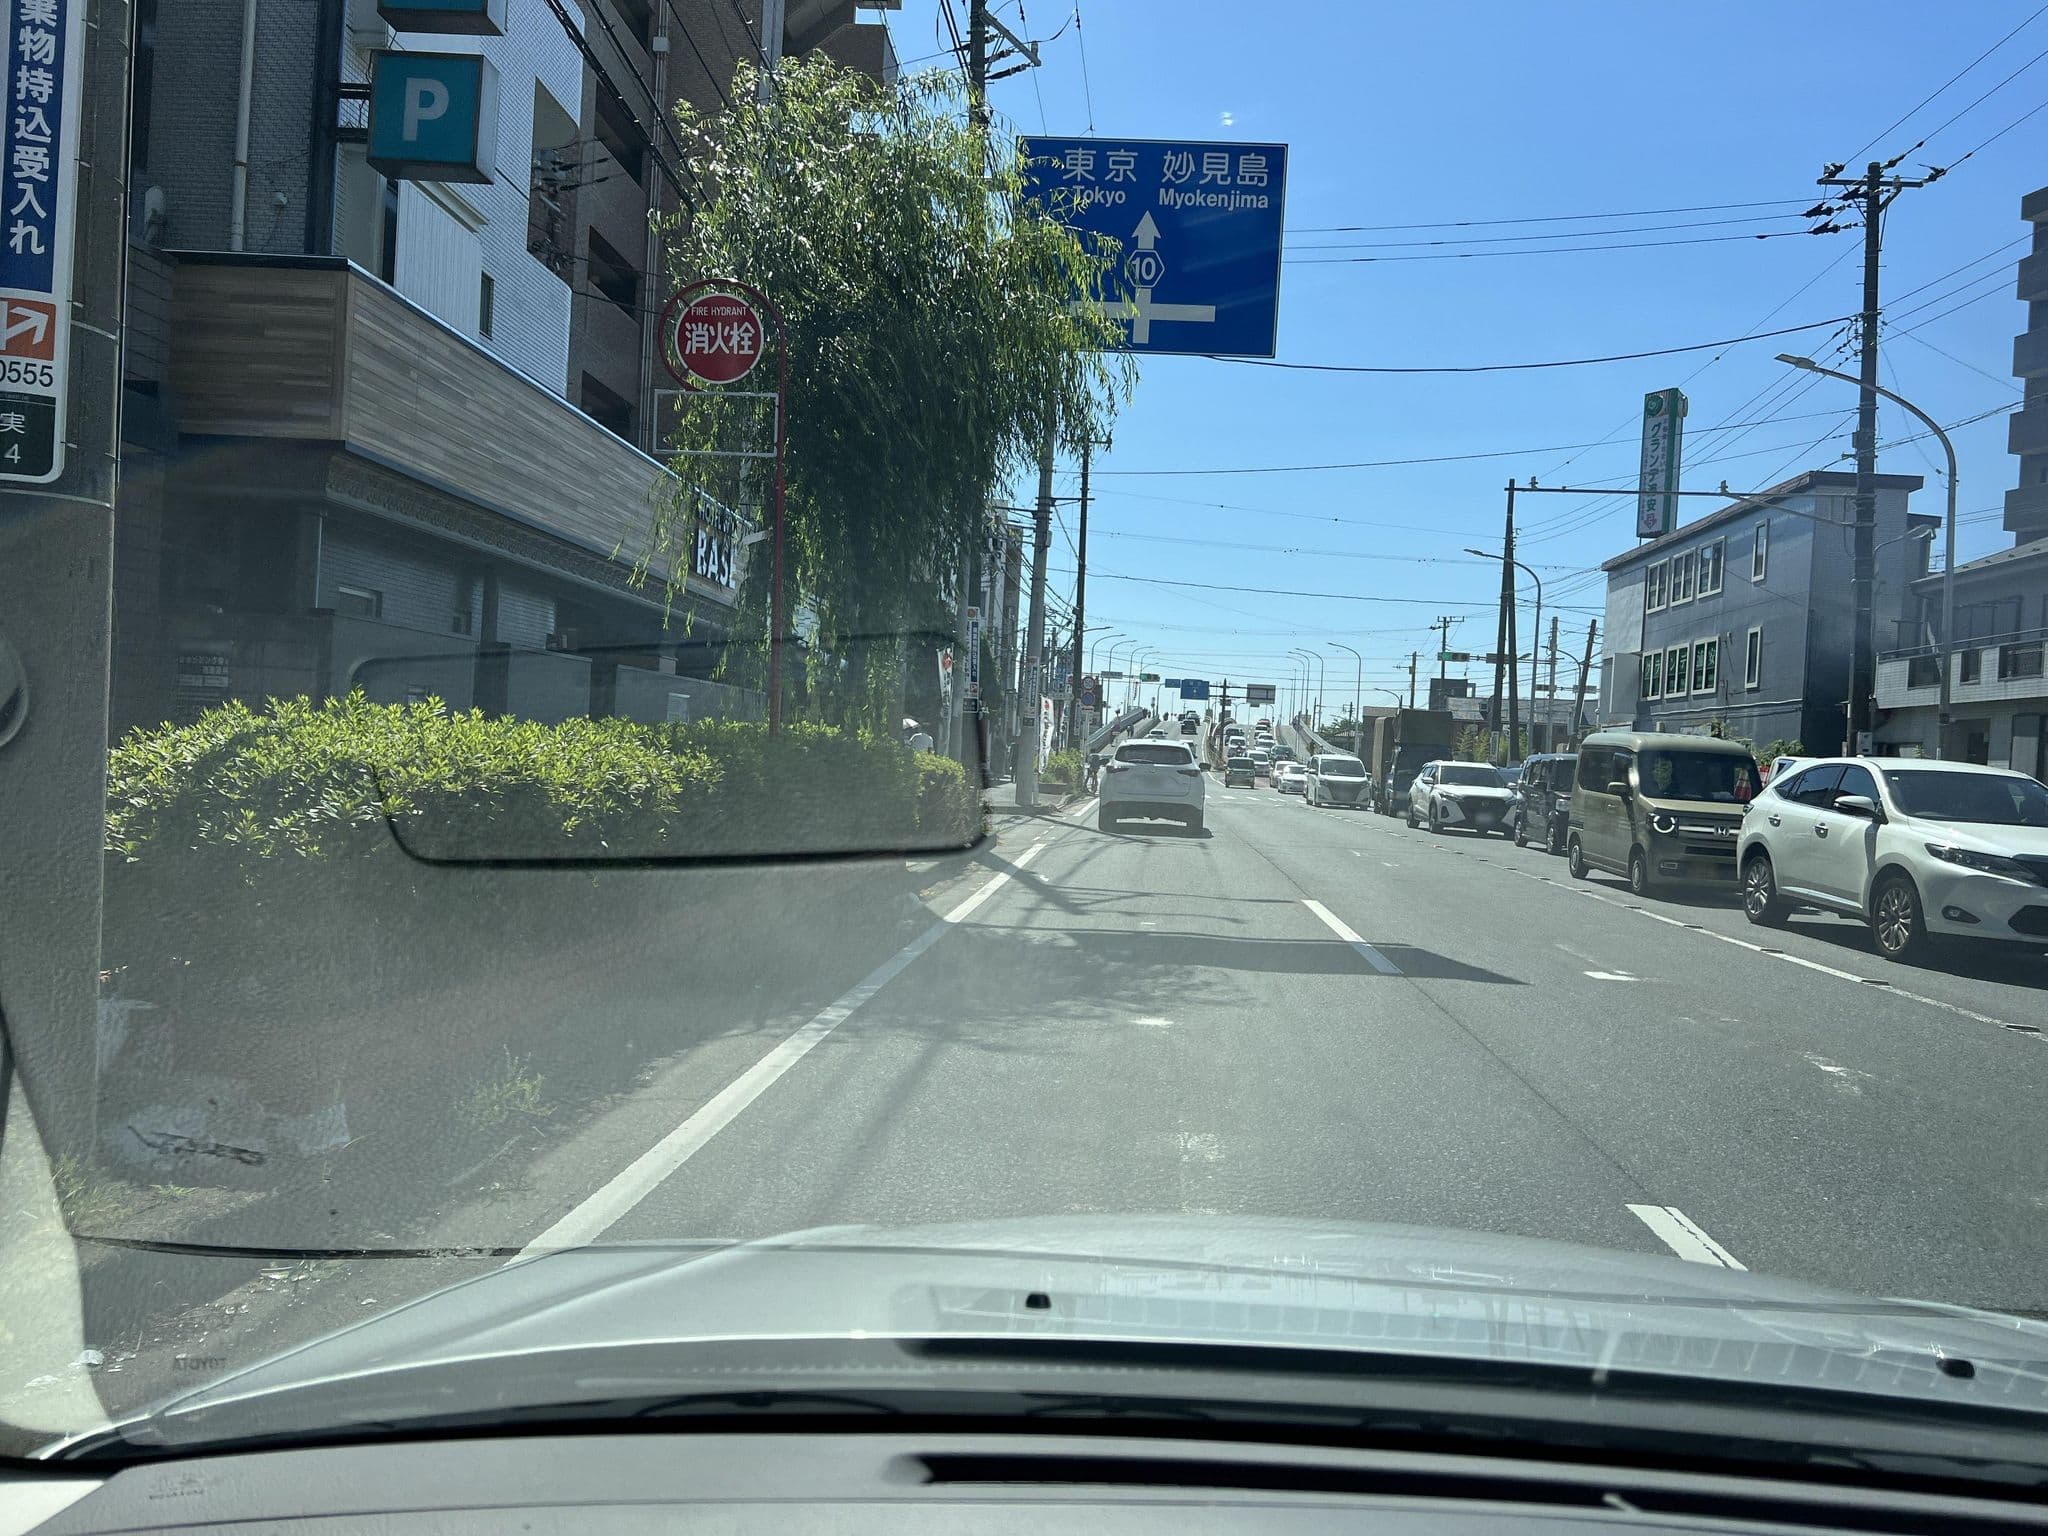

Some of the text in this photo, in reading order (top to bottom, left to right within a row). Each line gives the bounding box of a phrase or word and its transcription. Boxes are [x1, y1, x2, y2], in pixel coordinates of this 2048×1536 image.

[402, 77, 449, 141] P
[1062, 147, 1269, 187] 東京 妙見島
[1072, 184, 1269, 212] Tokyo Myokenjima
[1132, 257, 1156, 281] 10
[691, 306, 748, 317] FIRE HYDRANT
[684, 321, 756, 355] 消火栓
[0, 411, 25, 434] 実
[4, 443, 21, 464] 4
